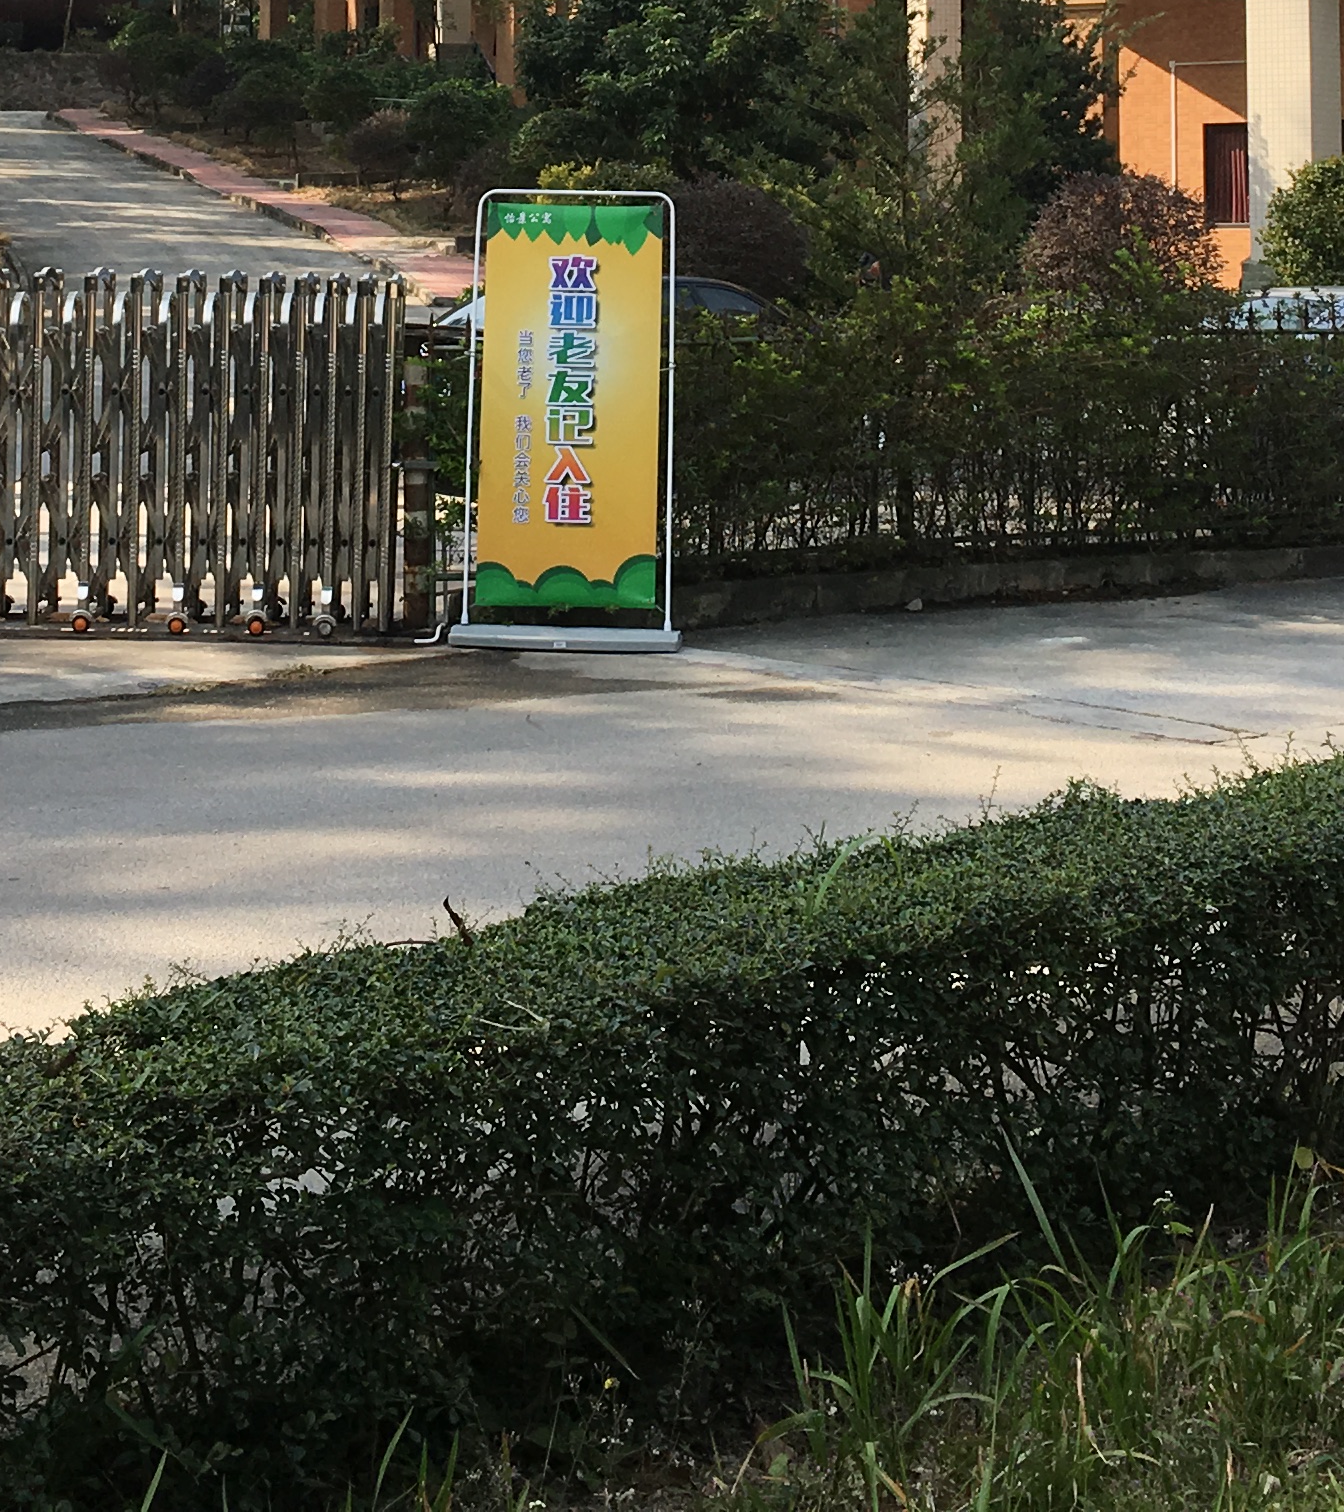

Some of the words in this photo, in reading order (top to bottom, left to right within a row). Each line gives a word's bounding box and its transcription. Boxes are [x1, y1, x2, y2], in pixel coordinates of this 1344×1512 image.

[504, 211, 552, 225] 怡景公寓
[518, 331, 533, 399] 当您老了
[544, 255, 596, 524] 欢迎老友记入住
[513, 416, 532, 523] 我们会关心您
